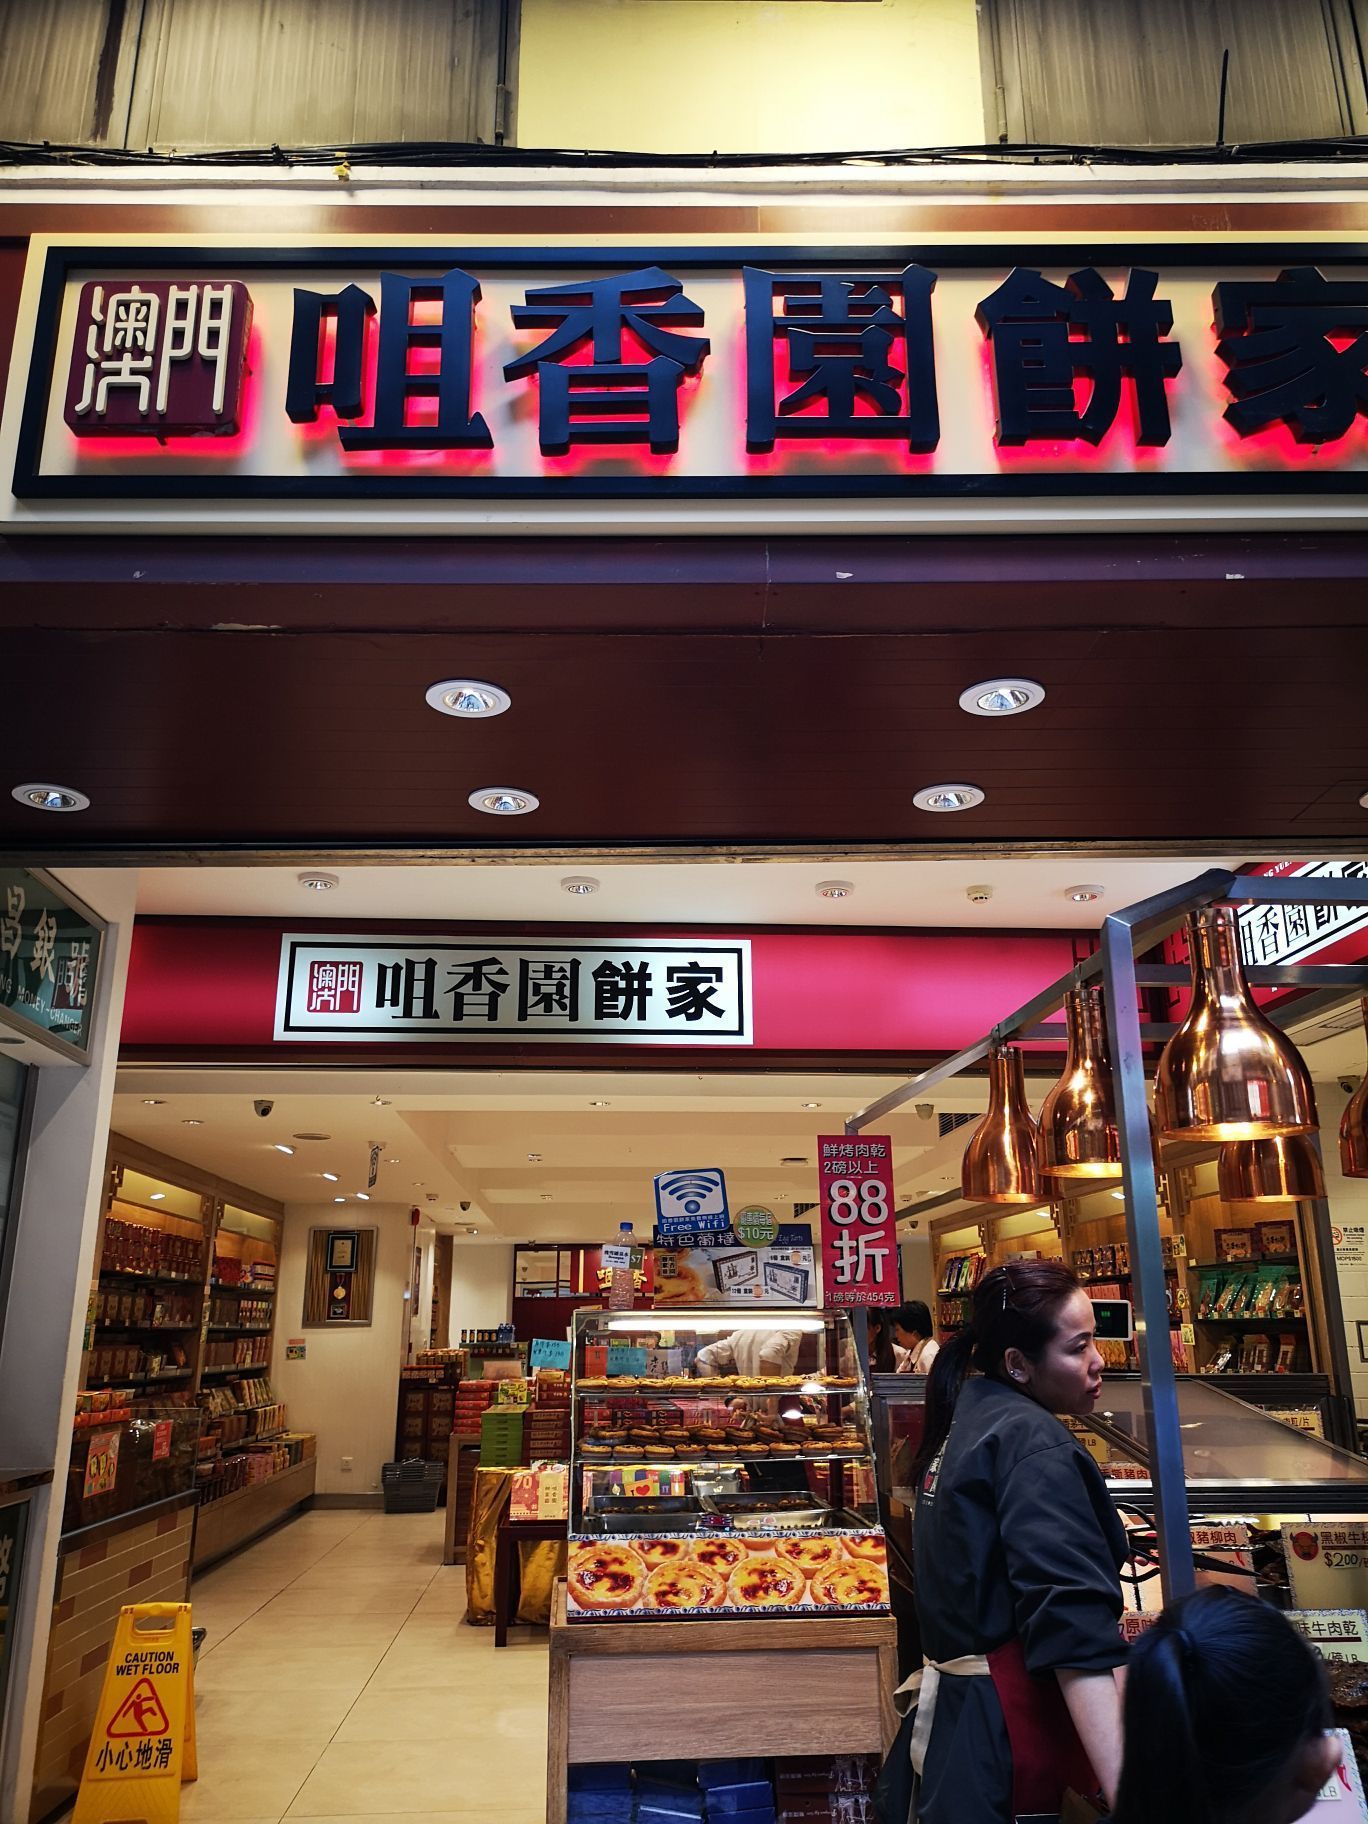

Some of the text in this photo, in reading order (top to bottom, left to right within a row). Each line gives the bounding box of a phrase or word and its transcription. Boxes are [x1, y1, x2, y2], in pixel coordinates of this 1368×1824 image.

[285, 264, 1368, 458] 咀香園餅家
[375, 957, 726, 1022] 咀香園餅家
[823, 1144, 886, 1158] 鮮烤肉乾
[824, 1161, 879, 1174] 2磅以上
[831, 1179, 889, 1225] 88
[698, 1219, 725, 1229] Wifi
[738, 1227, 774, 1240] $10元
[833, 1230, 889, 1283] 折
[124, 1651, 175, 1664] CAUTION
[115, 1662, 180, 1676] WET FLOOR
[95, 1738, 173, 1773] 小心地滑
